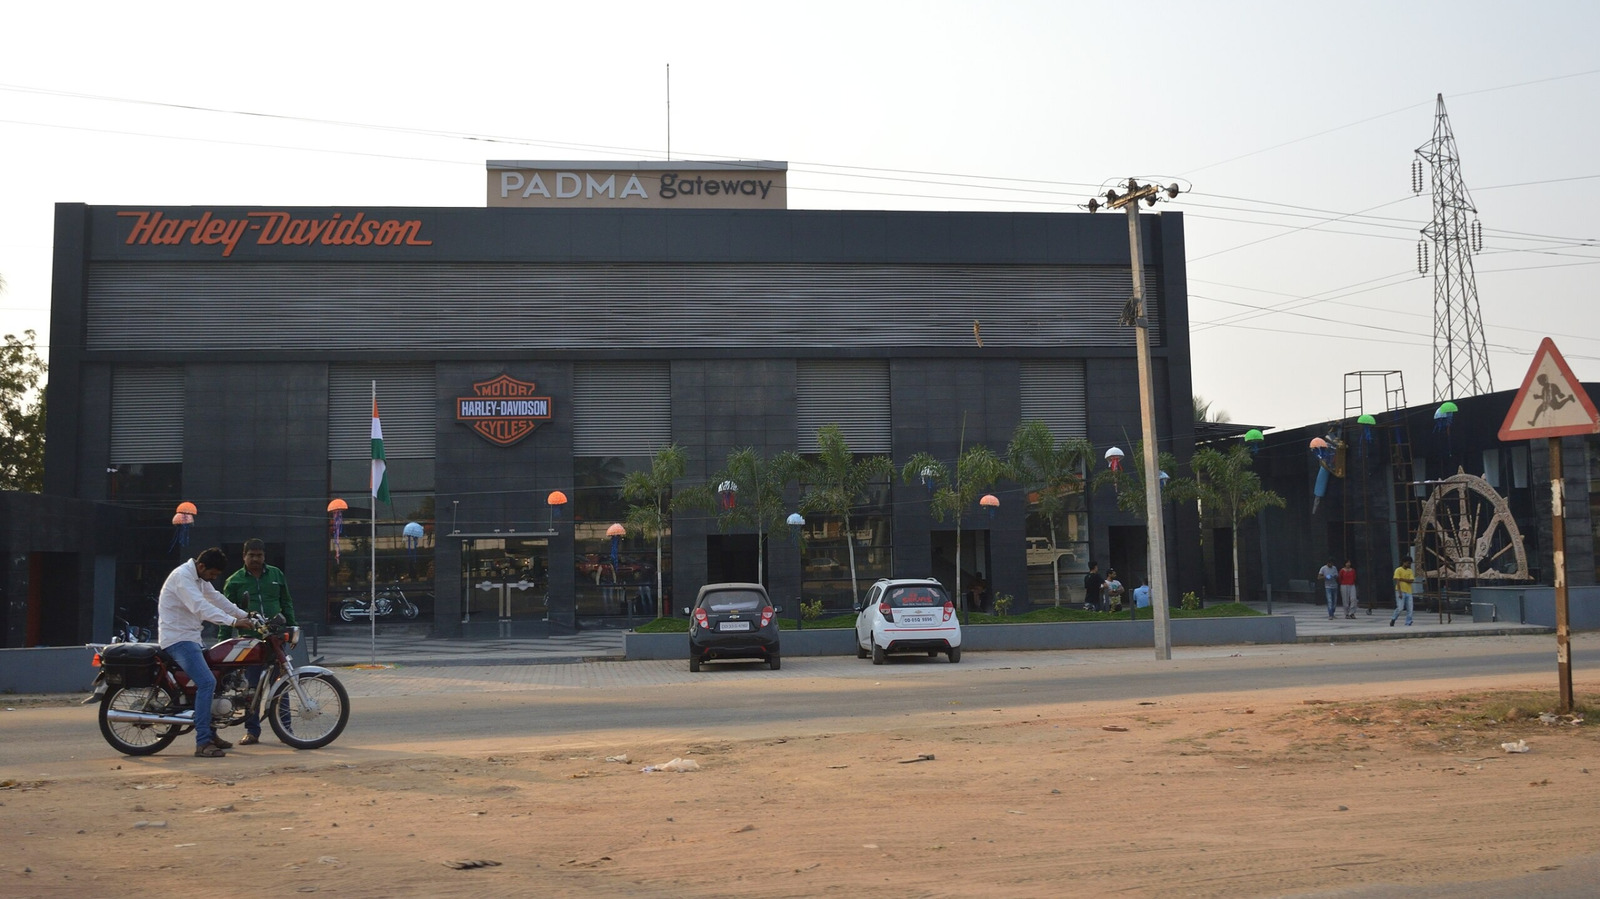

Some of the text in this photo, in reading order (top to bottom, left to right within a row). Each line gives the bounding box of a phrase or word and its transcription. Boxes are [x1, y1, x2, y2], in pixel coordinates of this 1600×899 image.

[500, 171, 772, 199] PADMA gateway
[116, 211, 433, 258] Harley-Davidson
[481, 380, 527, 396] MOTOR
[461, 400, 547, 416] HARLEY-DAVIDSON
[481, 420, 527, 439] CYCLES
